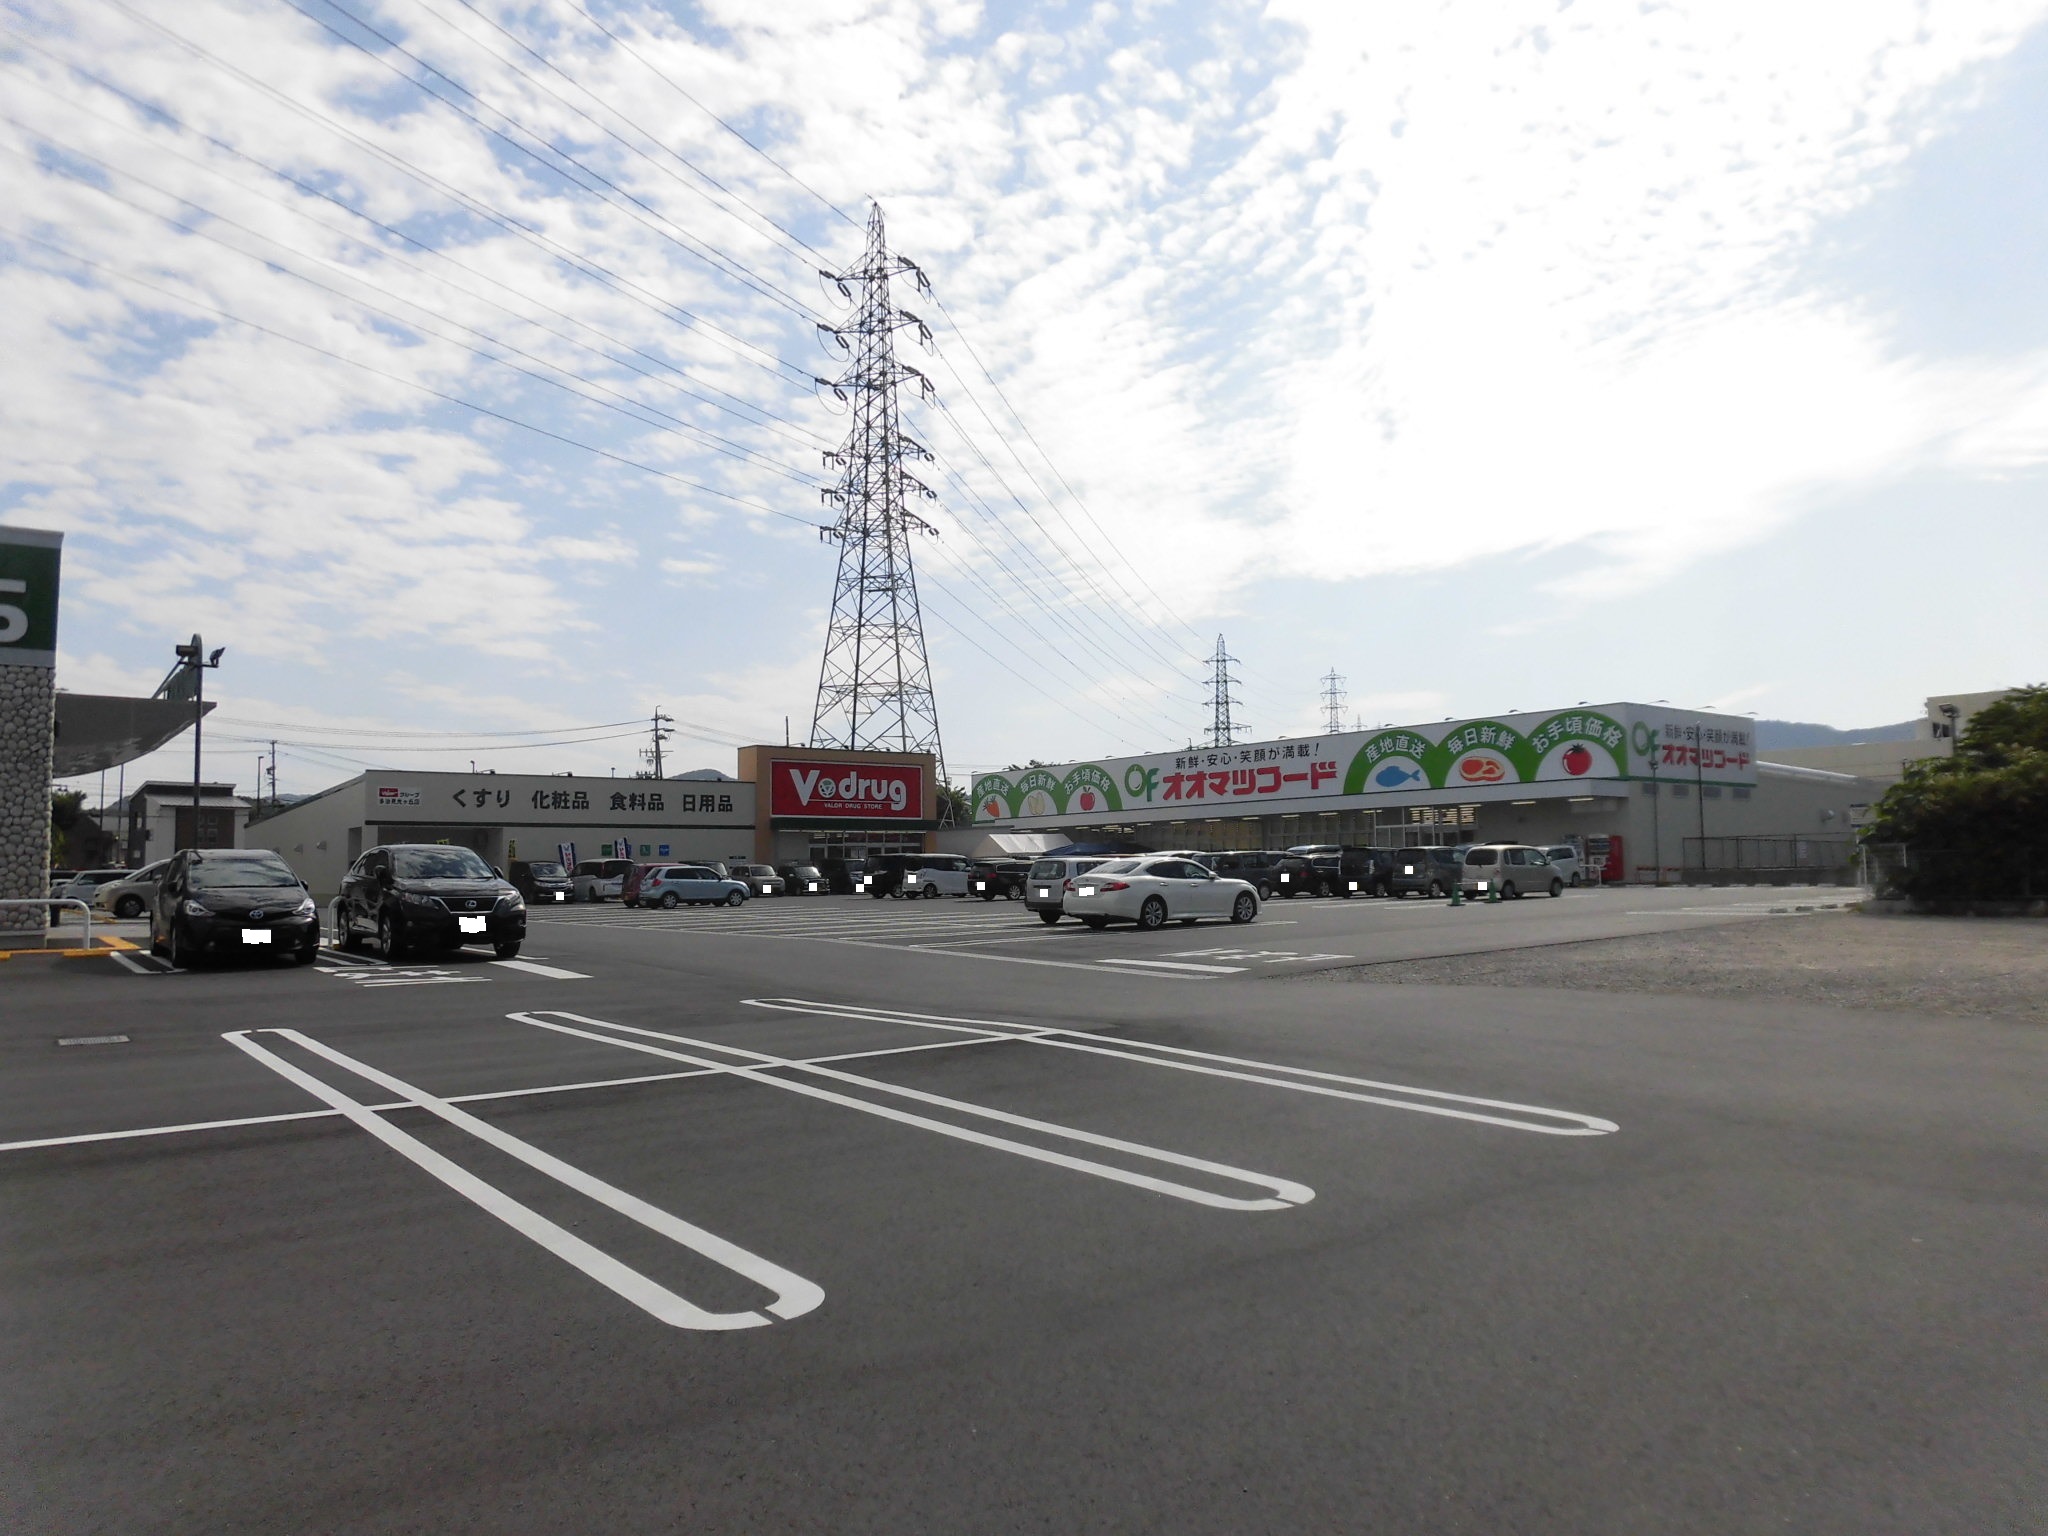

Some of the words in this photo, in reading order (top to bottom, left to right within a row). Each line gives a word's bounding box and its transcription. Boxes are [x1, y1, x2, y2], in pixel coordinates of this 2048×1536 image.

[1448, 726, 1516, 754] 毎日新鮮
[1532, 716, 1623, 754] お手頃価格
[1365, 735, 1427, 764] 産地直送
[1064, 768, 1110, 794] お手頃価格
[452, 789, 510, 808] くすり
[531, 790, 590, 810] 化粧品
[610, 792, 665, 812] 食料品
[682, 794, 733, 813] 日用品
